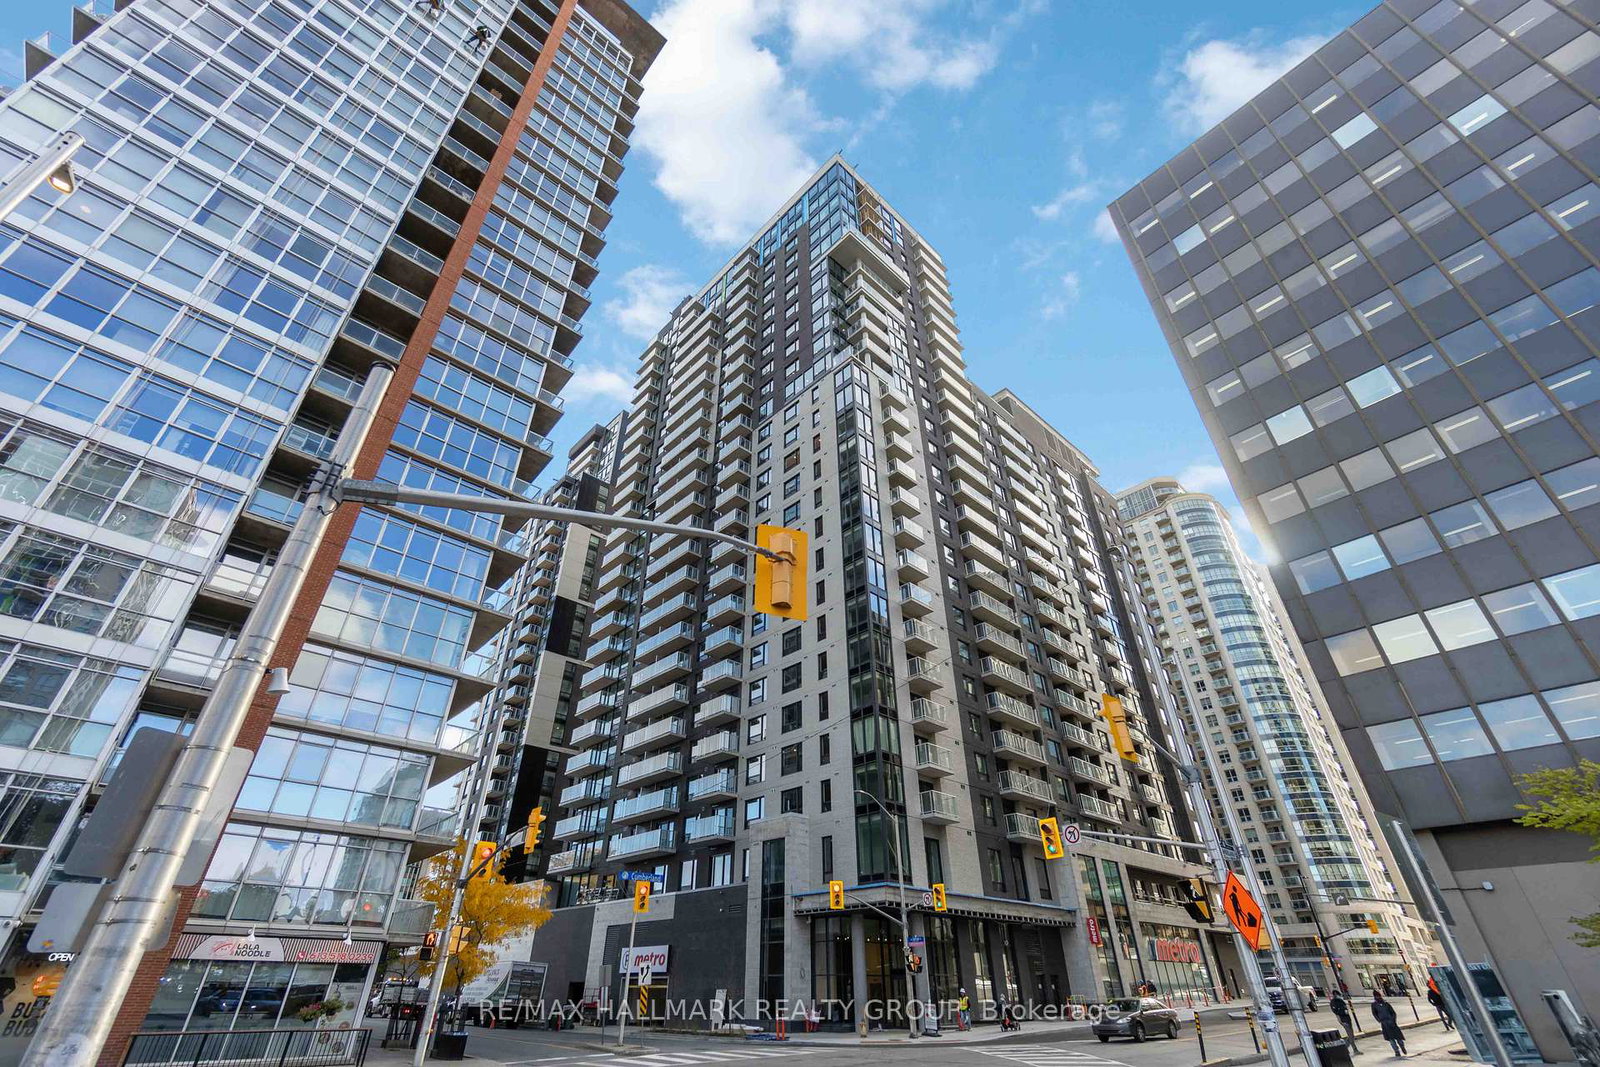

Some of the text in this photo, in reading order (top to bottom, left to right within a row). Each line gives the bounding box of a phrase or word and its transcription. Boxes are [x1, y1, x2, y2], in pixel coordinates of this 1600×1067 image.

[1089, 918, 1098, 944] metro
[237, 943, 260, 951] LALA
[1155, 936, 1200, 963] metro
[48, 953, 75, 962] OPEN
[633, 952, 666, 967] metro
